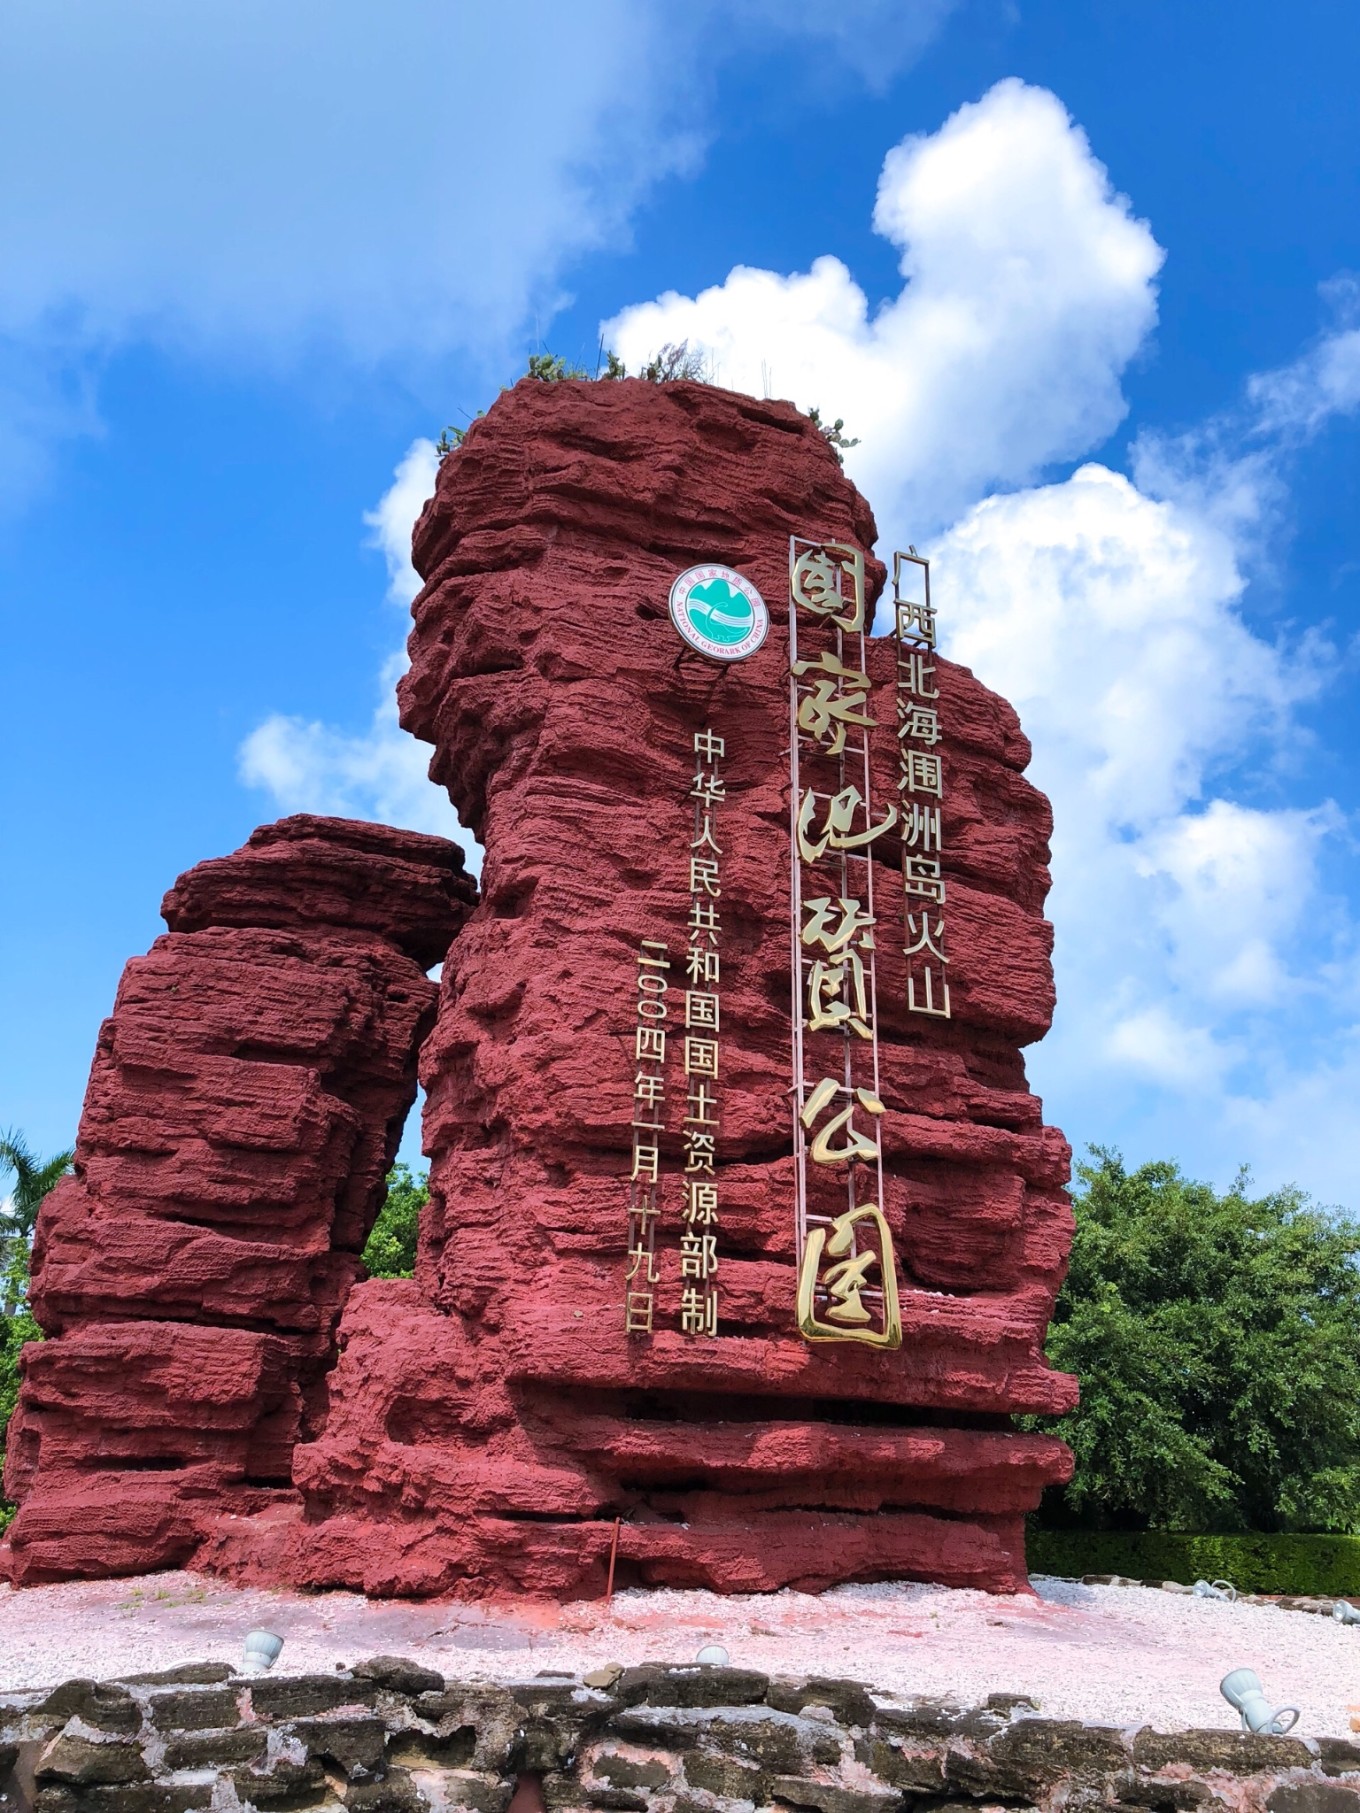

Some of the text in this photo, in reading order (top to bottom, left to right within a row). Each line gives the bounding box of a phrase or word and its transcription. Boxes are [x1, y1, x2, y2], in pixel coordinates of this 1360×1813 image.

[676, 600, 700, 642] NATIONAL
[750, 618, 764, 643] CHINA
[893, 545, 951, 1019] 广西北海涠洲岛火山
[680, 728, 725, 1337] 中华人民共和国国土资源部制
